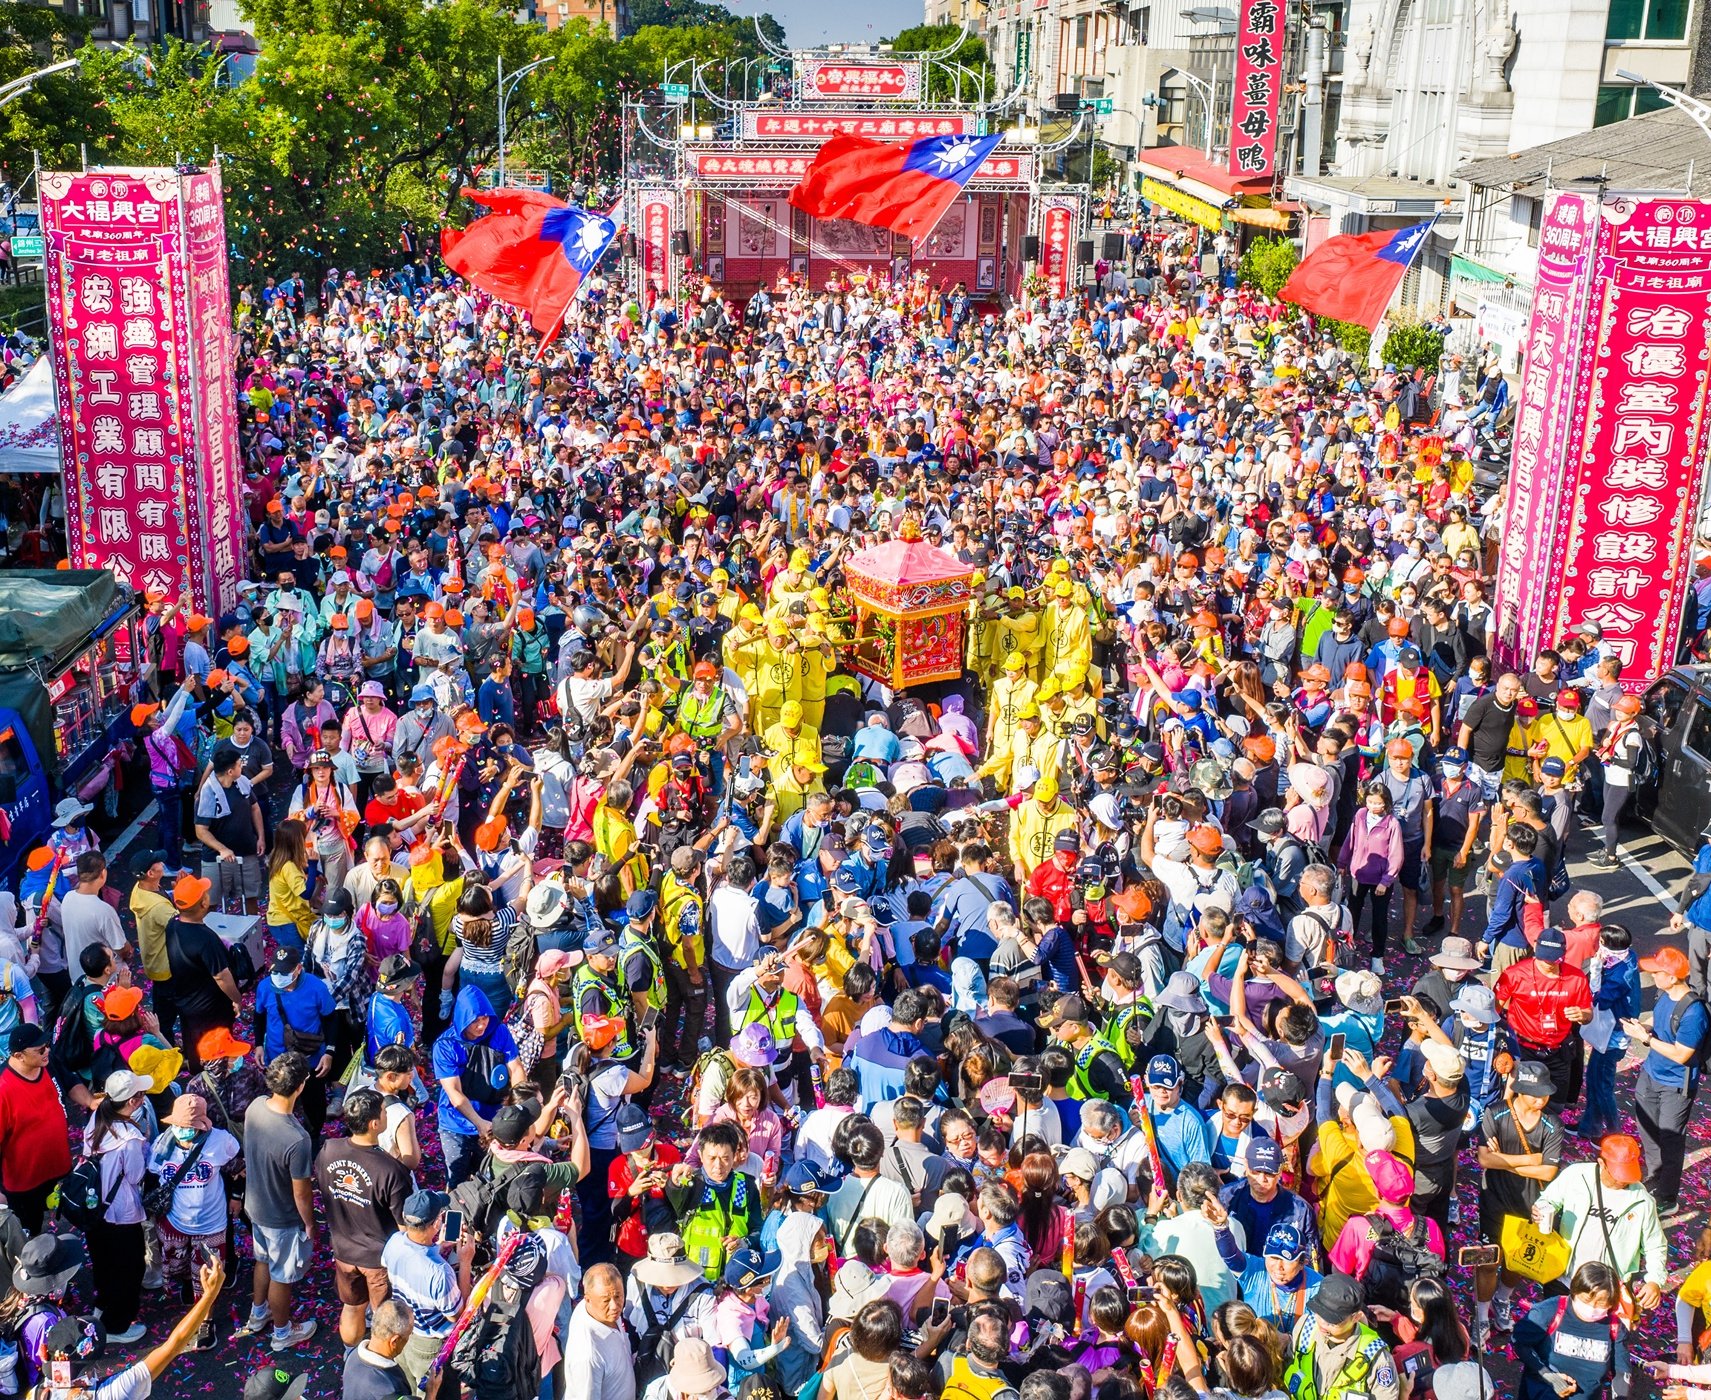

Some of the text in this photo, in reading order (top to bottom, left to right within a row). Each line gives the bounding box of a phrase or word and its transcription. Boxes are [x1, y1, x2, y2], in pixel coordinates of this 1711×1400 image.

[826, 68, 895, 85] 大福興宮
[1236, 1, 1280, 173] 霸味薑母鴨
[61, 200, 161, 223] 大福興宮
[189, 203, 218, 228] 360周年
[1556, 203, 1579, 227] 建廟
[79, 229, 145, 240] 建廟360周年
[1544, 226, 1582, 252] 360周年
[78, 248, 149, 262] 月老祖廟
[1633, 255, 1703, 267] 建廟360周年
[1627, 275, 1704, 289] 月老祖廟
[201, 305, 237, 617] 大福興宮月老祖廟
[1499, 322, 1555, 652] 大福興宮月老祖廟
[326, 1160, 373, 1187] POINT ROBERTS
